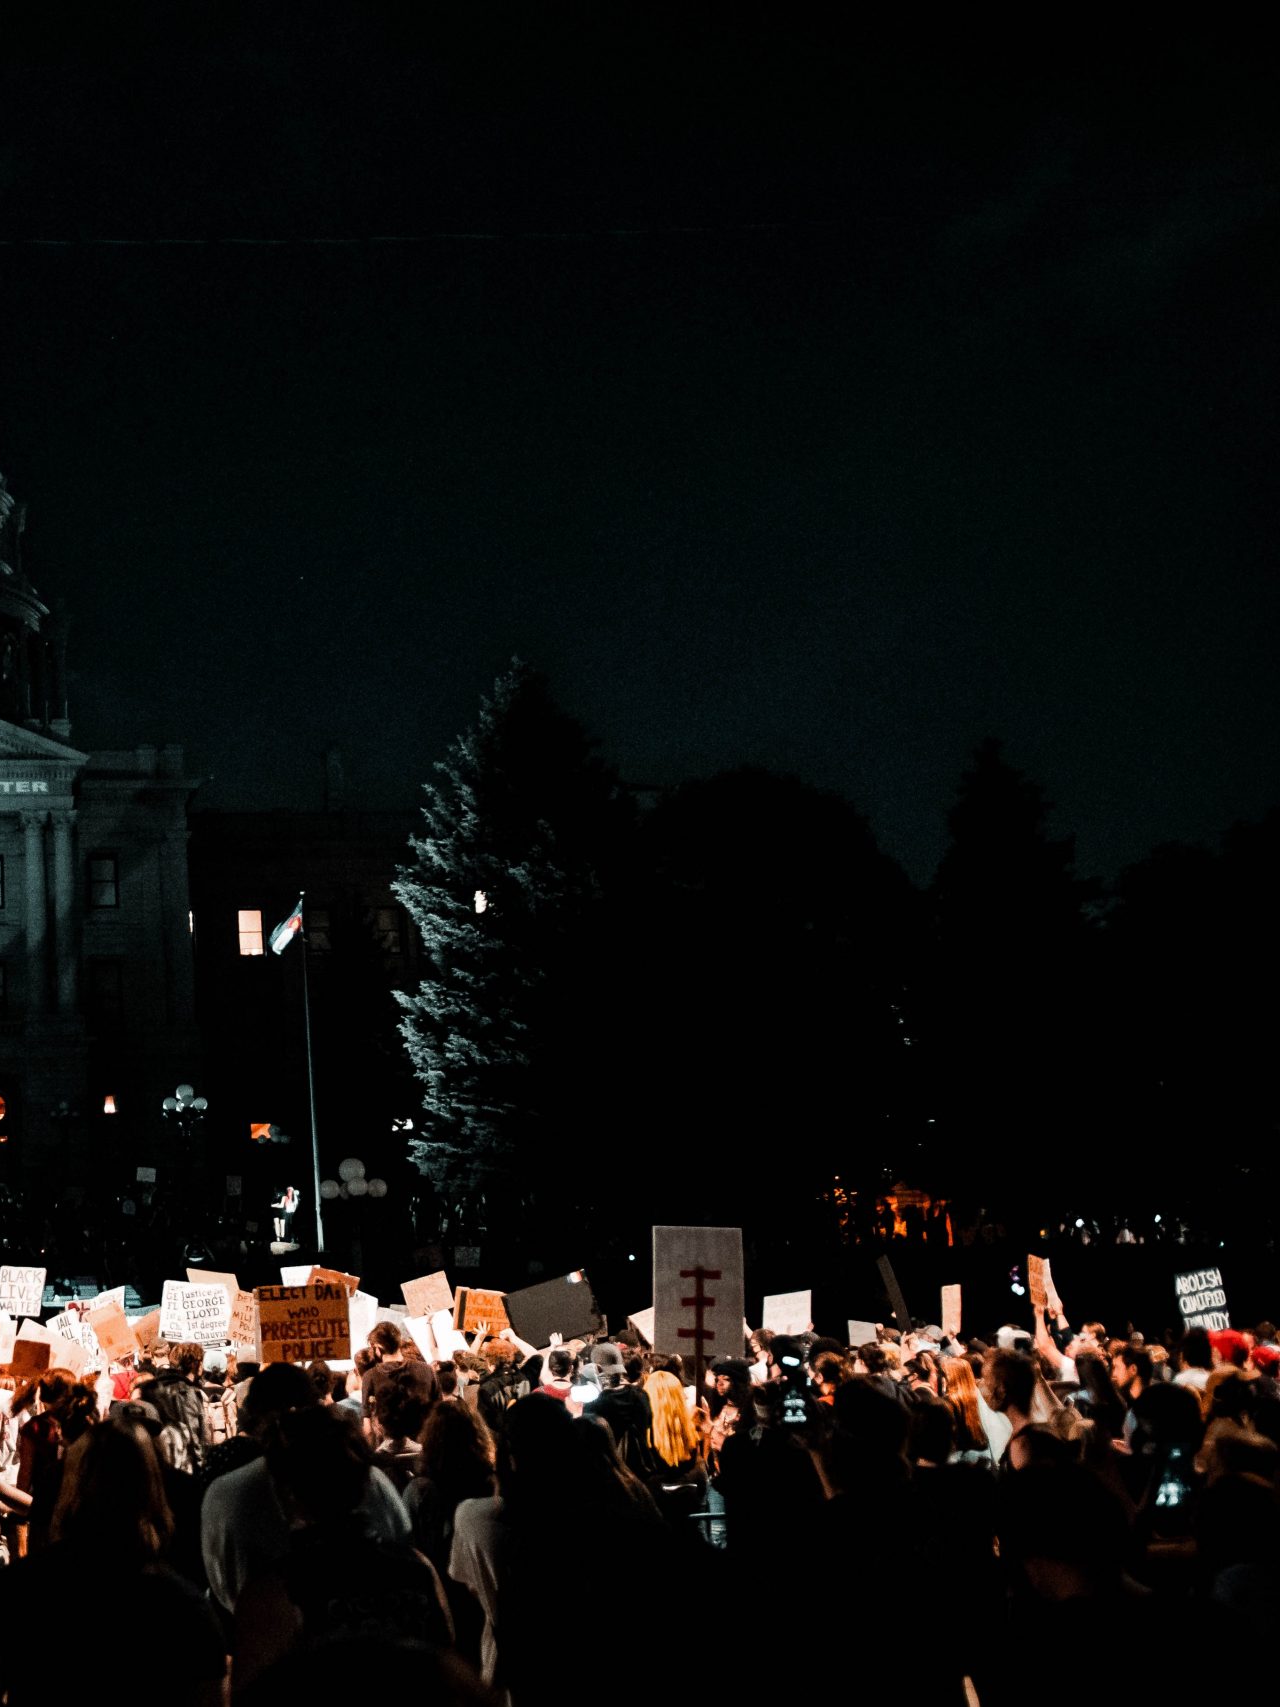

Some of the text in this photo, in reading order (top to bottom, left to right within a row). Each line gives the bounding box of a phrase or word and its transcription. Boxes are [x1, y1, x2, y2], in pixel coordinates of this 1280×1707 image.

[1, 1269, 41, 1283] BLACK
[1176, 1267, 1223, 1294] ABOLISH
[0, 1284, 41, 1301] LIVES
[181, 1290, 212, 1301] Justice
[259, 1285, 307, 1301] ELECT
[182, 1296, 225, 1309] GEORGE
[287, 1306, 320, 1319] WHO
[200, 1320, 227, 1331] degree
[260, 1319, 349, 1340] PROSECUTE
[282, 1341, 336, 1361] POLICE
